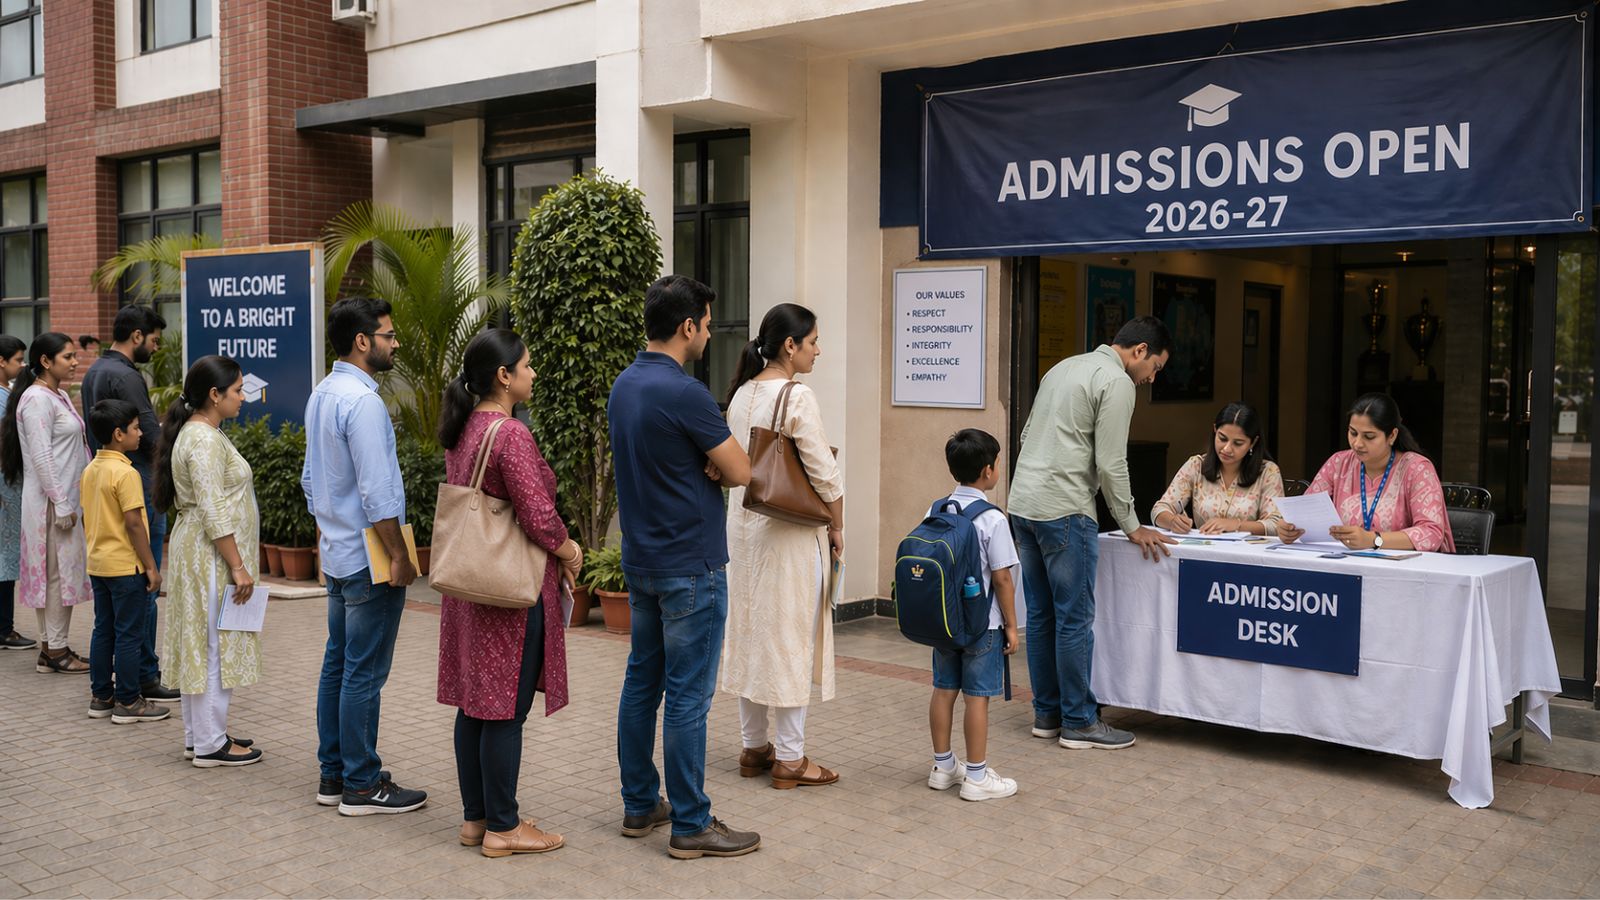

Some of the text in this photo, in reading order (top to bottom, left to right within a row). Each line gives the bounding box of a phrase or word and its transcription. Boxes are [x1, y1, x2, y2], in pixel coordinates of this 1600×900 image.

[998, 122, 1470, 202] ADMISSIONS OPEN
[1145, 195, 1288, 233] 2026-27
[208, 275, 286, 297] WELCOME
[915, 290, 965, 300] OUR VALUES
[201, 307, 295, 328] TO A BRIGHT
[912, 309, 946, 318] RESPECT
[912, 325, 973, 334] RESPONSIBILITY
[218, 338, 277, 358] FUTURE
[912, 341, 952, 350] INTEGRITY
[911, 357, 960, 366] EXCELLENCE
[911, 373, 947, 382] EMPATHY
[1207, 581, 1338, 617] ADMISSION
[1237, 618, 1299, 647] DESK
